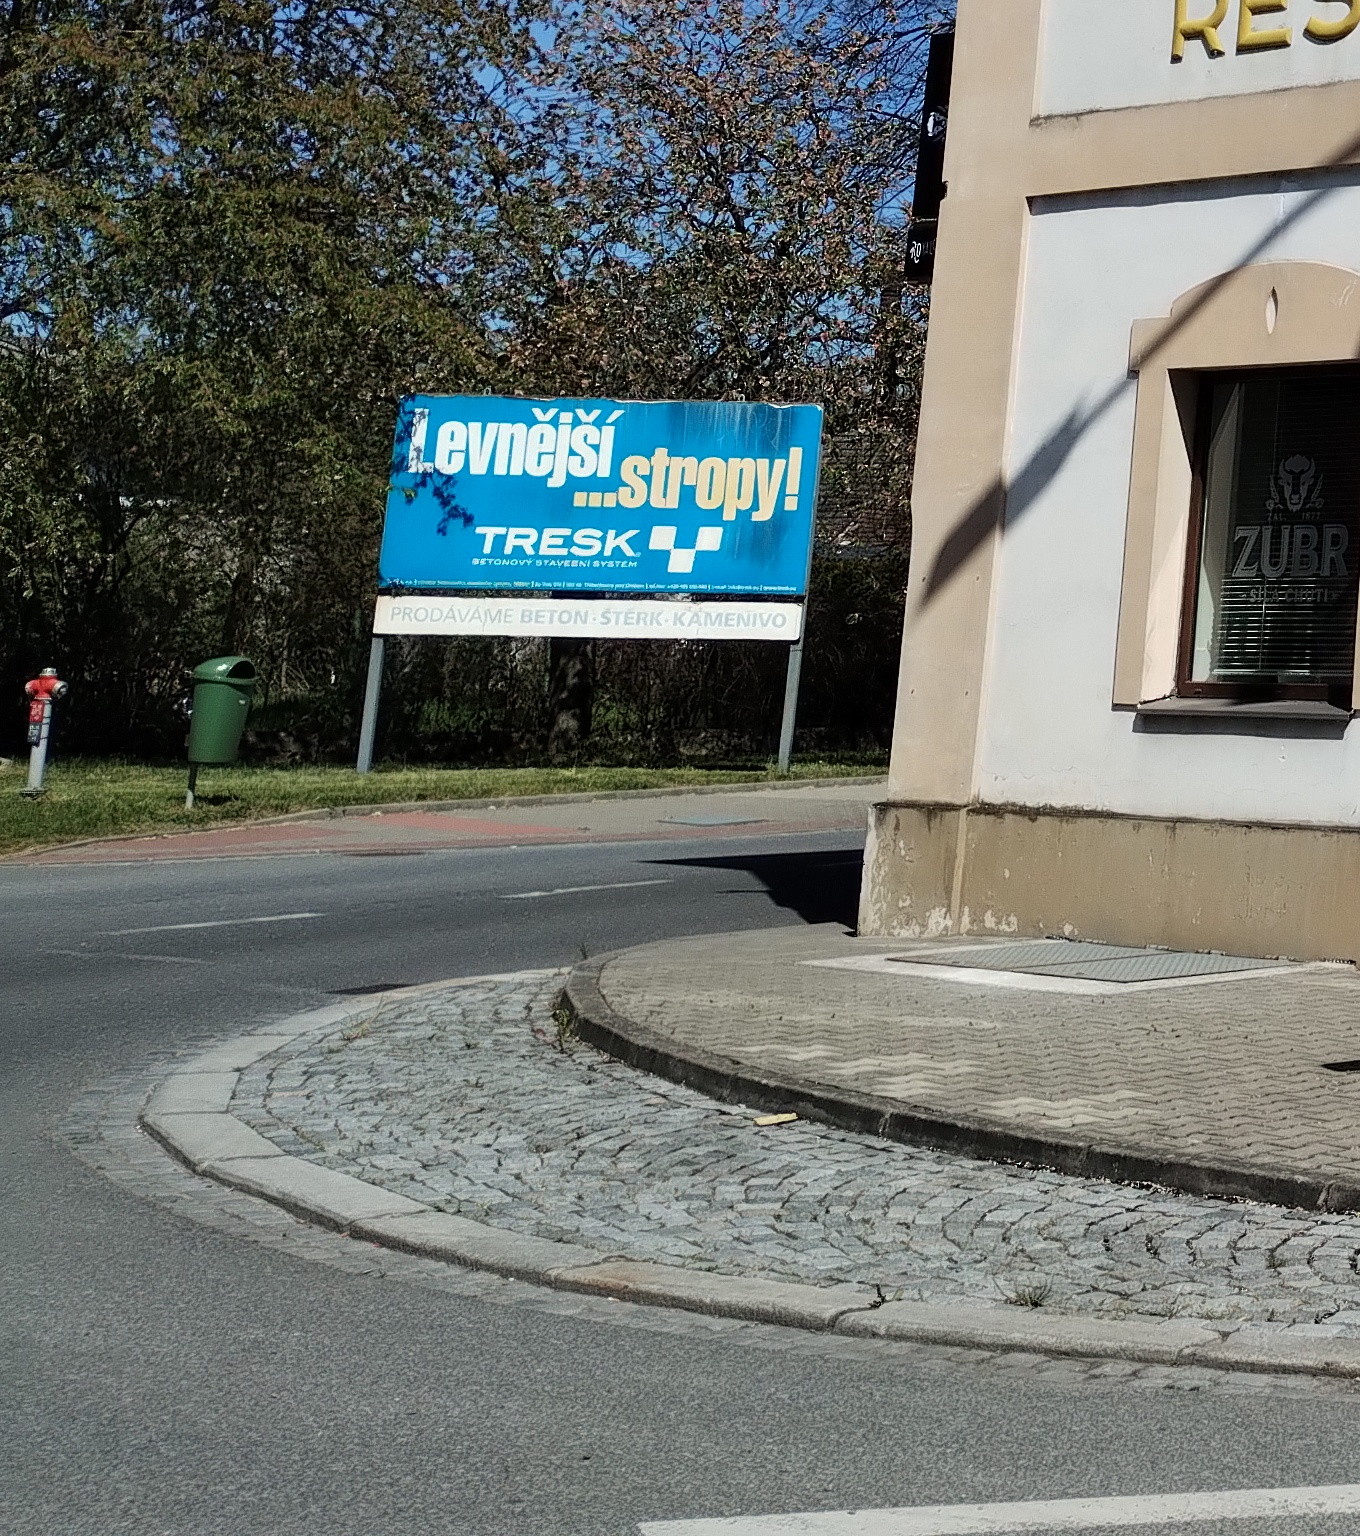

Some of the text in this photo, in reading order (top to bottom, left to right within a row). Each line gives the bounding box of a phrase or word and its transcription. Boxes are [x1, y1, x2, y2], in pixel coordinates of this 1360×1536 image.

[407, 408, 625, 488] Levnější
[475, 526, 640, 557] TRESK
[1232, 524, 1349, 578] ZUBR
[390, 605, 514, 625] PRODÁVÁME
[520, 609, 588, 625] BETON
[672, 611, 787, 628] KAMENIVO
